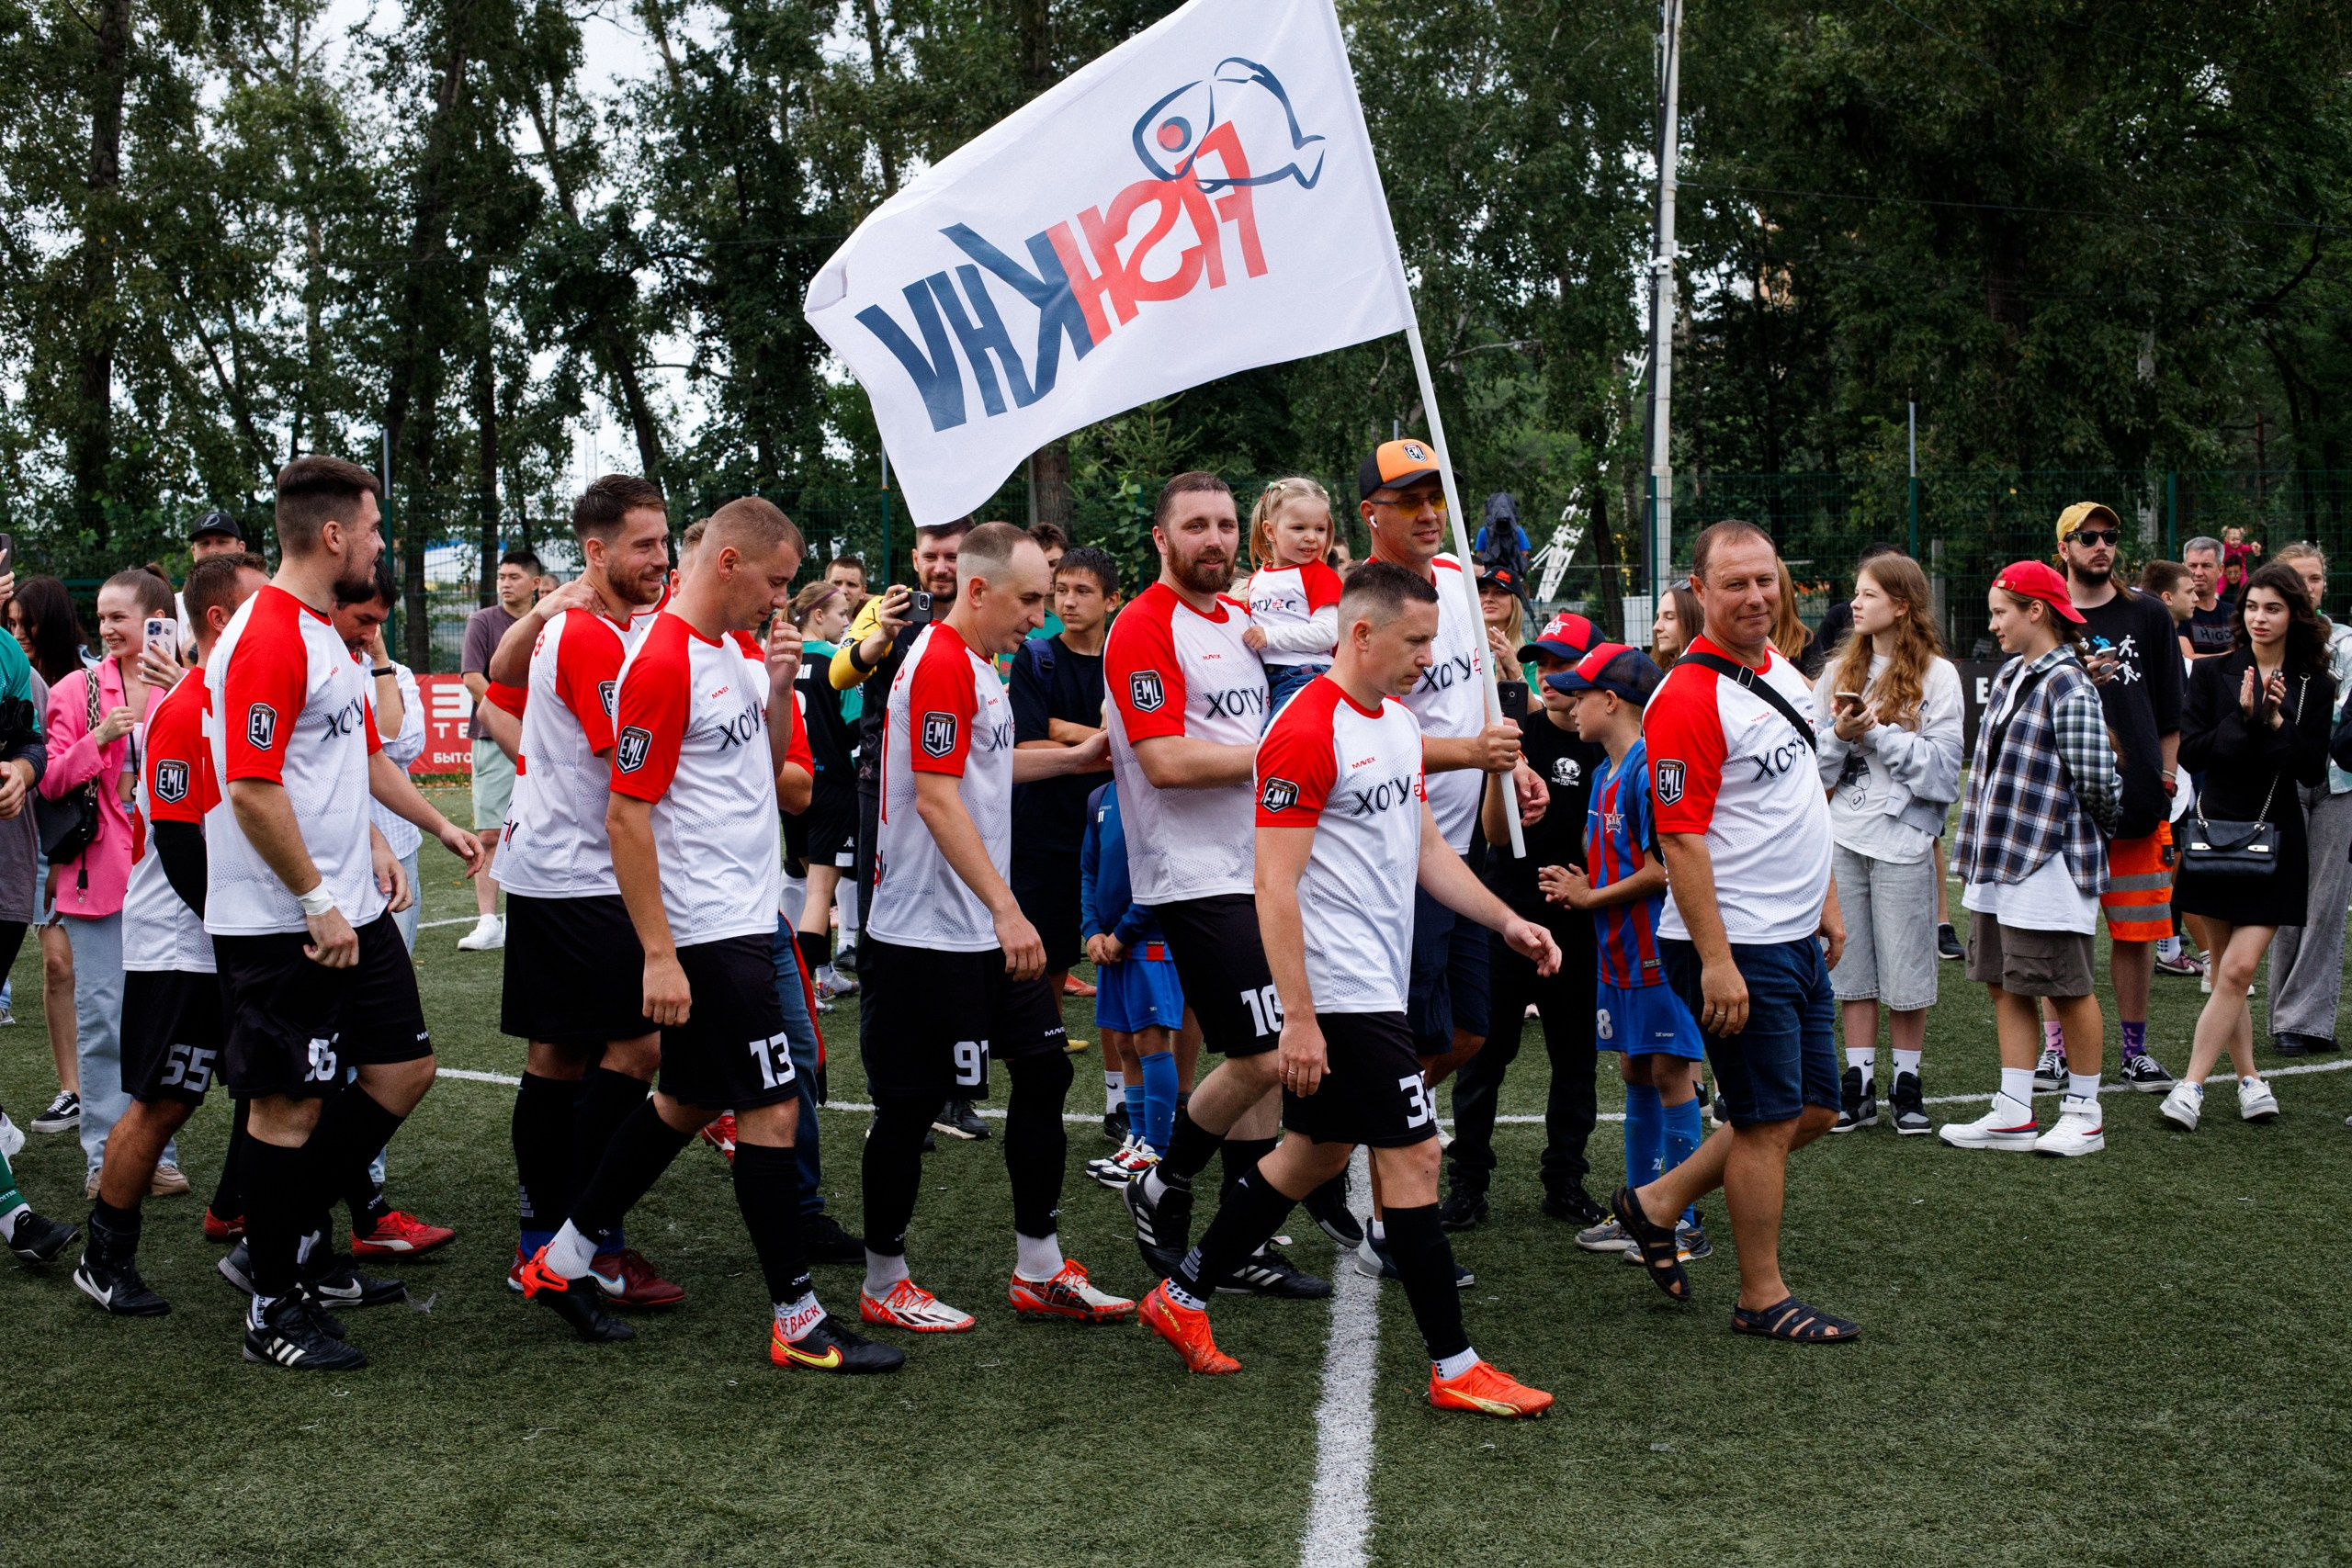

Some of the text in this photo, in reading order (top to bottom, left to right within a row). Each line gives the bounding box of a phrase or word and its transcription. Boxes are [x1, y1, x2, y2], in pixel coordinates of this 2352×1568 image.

[1134, 679, 1161, 701] EML
[1203, 685, 1265, 721] ХОТУ
[251, 713, 271, 735] EM
[925, 721, 953, 746] EML
[433, 752, 472, 763] БЫТО
[618, 736, 646, 762] EML
[159, 768, 185, 793] EML
[1560, 777, 1579, 786] FUTURE
[1658, 769, 1681, 792] EML
[1597, 1009, 1613, 1040] 8
[161, 1043, 217, 1092] 55
[749, 1032, 796, 1089] 13
[954, 1040, 989, 1086] 91
[1398, 1069, 1435, 1129] 3
[790, 1304, 820, 1335] BACK
